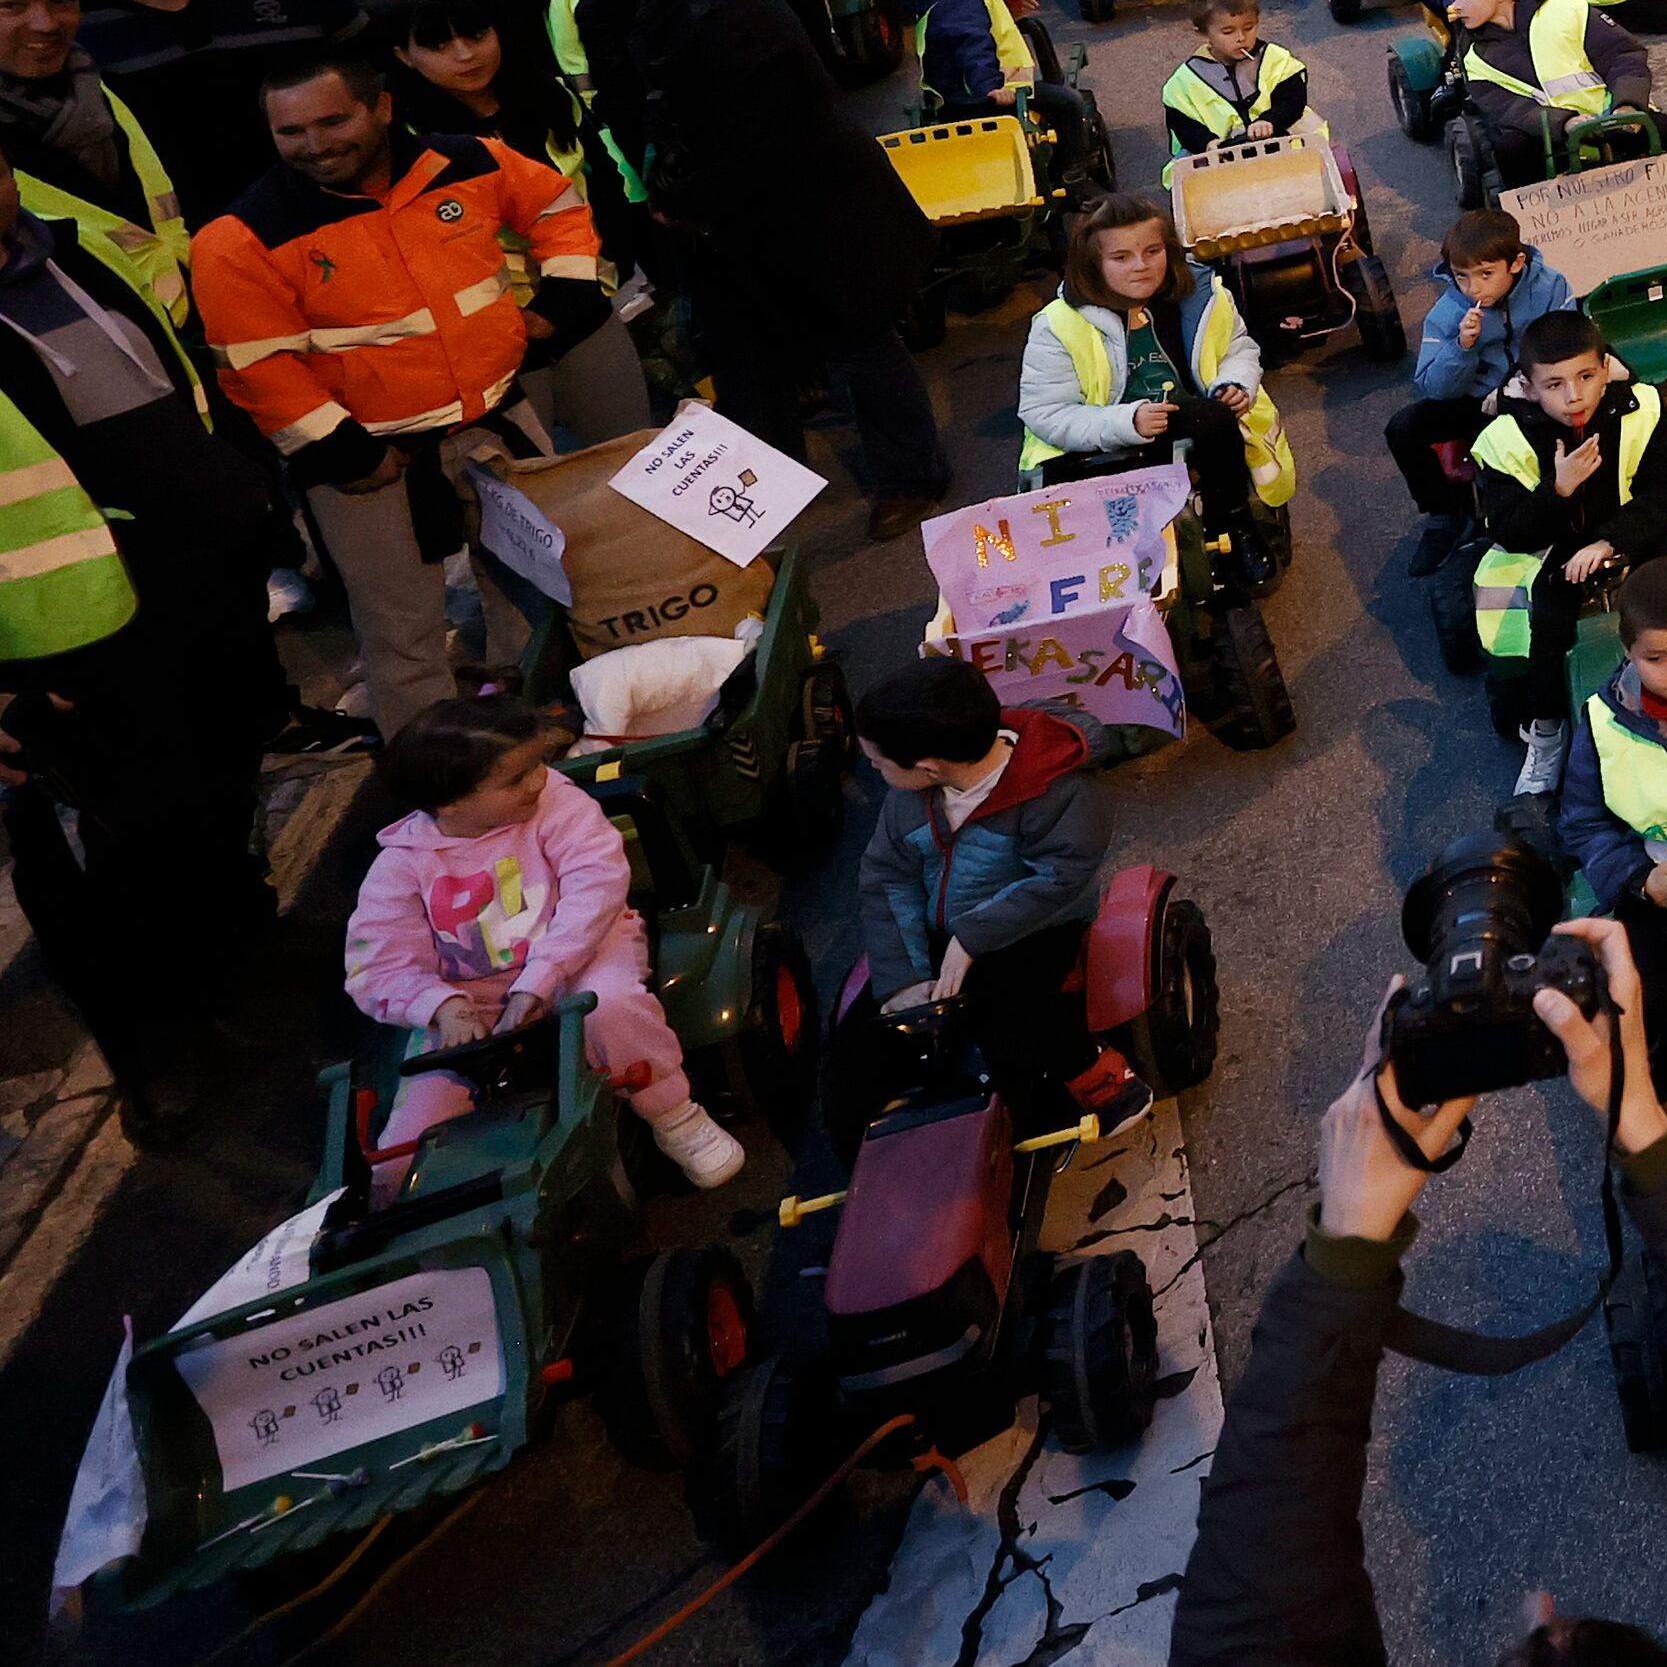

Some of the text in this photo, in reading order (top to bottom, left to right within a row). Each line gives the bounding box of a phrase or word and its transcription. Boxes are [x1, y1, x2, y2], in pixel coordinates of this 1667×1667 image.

[1516, 186, 1552, 210] POR
[1556, 168, 1634, 200] NUESTRO
[1531, 211, 1560, 230] NO
[1574, 205, 1585, 219] A
[645, 429, 695, 475] NO SALEN
[672, 443, 729, 497] CUENTAS!!!
[674, 451, 696, 470] LAS
[519, 515, 553, 549] TRIGO
[973, 498, 1077, 569] NI
[597, 583, 719, 639] TRIGO
[248, 1295, 436, 1371] NO SALEN LAS
[280, 1322, 428, 1382] CUENTAS!!!
